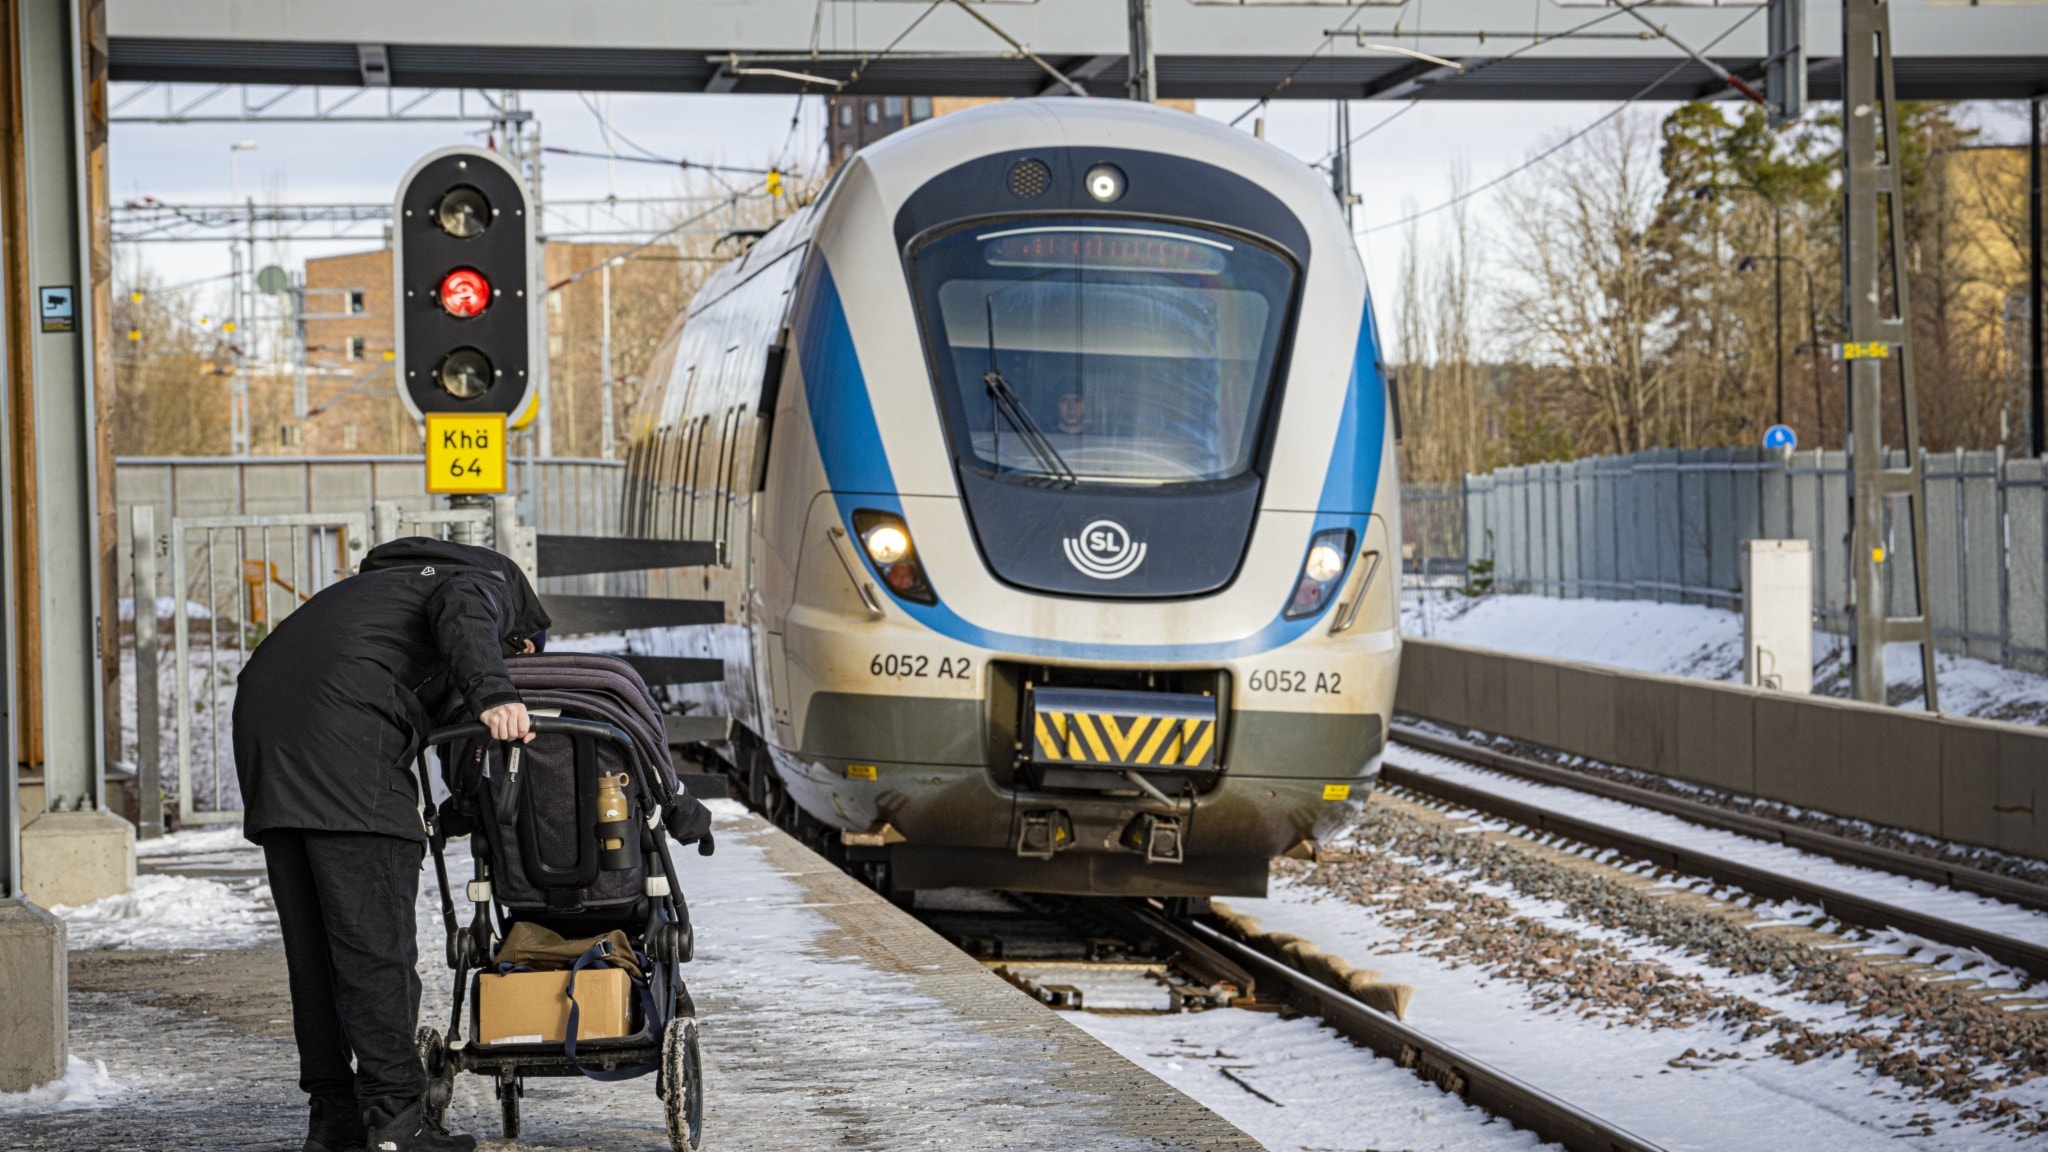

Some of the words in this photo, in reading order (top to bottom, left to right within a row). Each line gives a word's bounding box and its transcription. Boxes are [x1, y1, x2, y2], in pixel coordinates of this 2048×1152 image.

[443, 429, 488, 449] Khä
[450, 457, 482, 477] 64
[1090, 531, 1121, 552] SL
[870, 653, 929, 677] 6052
[937, 656, 971, 680] A2
[1248, 669, 1306, 692] 6052
[1314, 672, 1342, 694] A2
